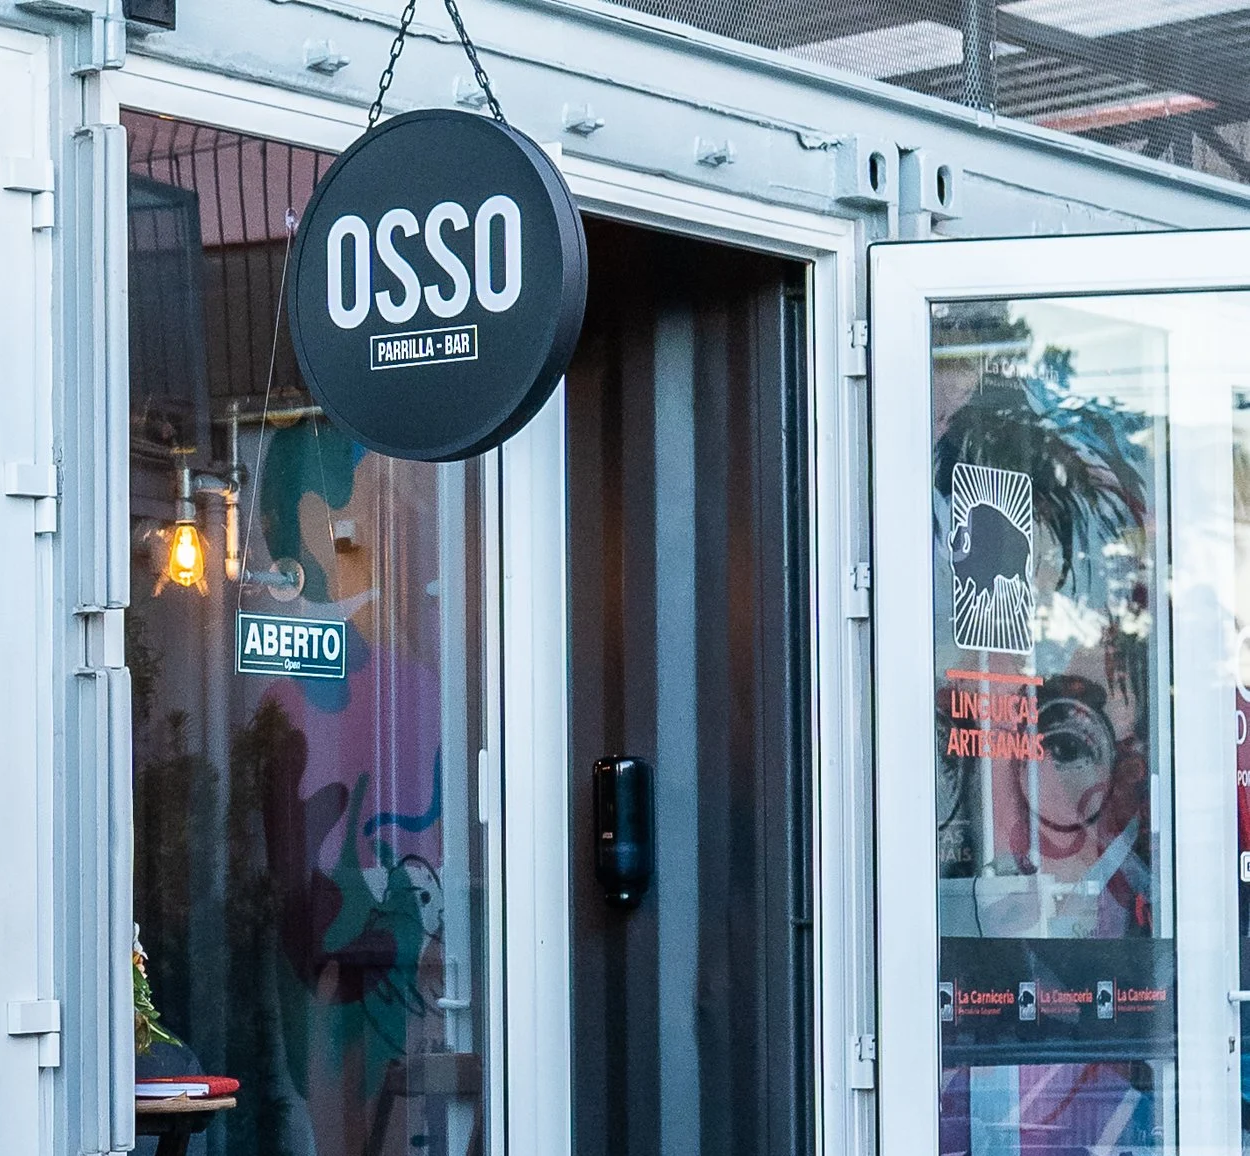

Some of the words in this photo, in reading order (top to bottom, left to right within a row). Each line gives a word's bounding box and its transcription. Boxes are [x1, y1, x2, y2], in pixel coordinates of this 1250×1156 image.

[327, 194, 522, 329] OSSO
[378, 336, 434, 362] PARRILLA
[444, 333, 470, 354] BAR
[244, 622, 341, 661] ABERTO
[284, 658, 301, 672] Open
[951, 689, 1039, 731] LINGUIÇAS
[947, 727, 1045, 762] ARTESANAIS
[957, 989, 969, 1005] La
